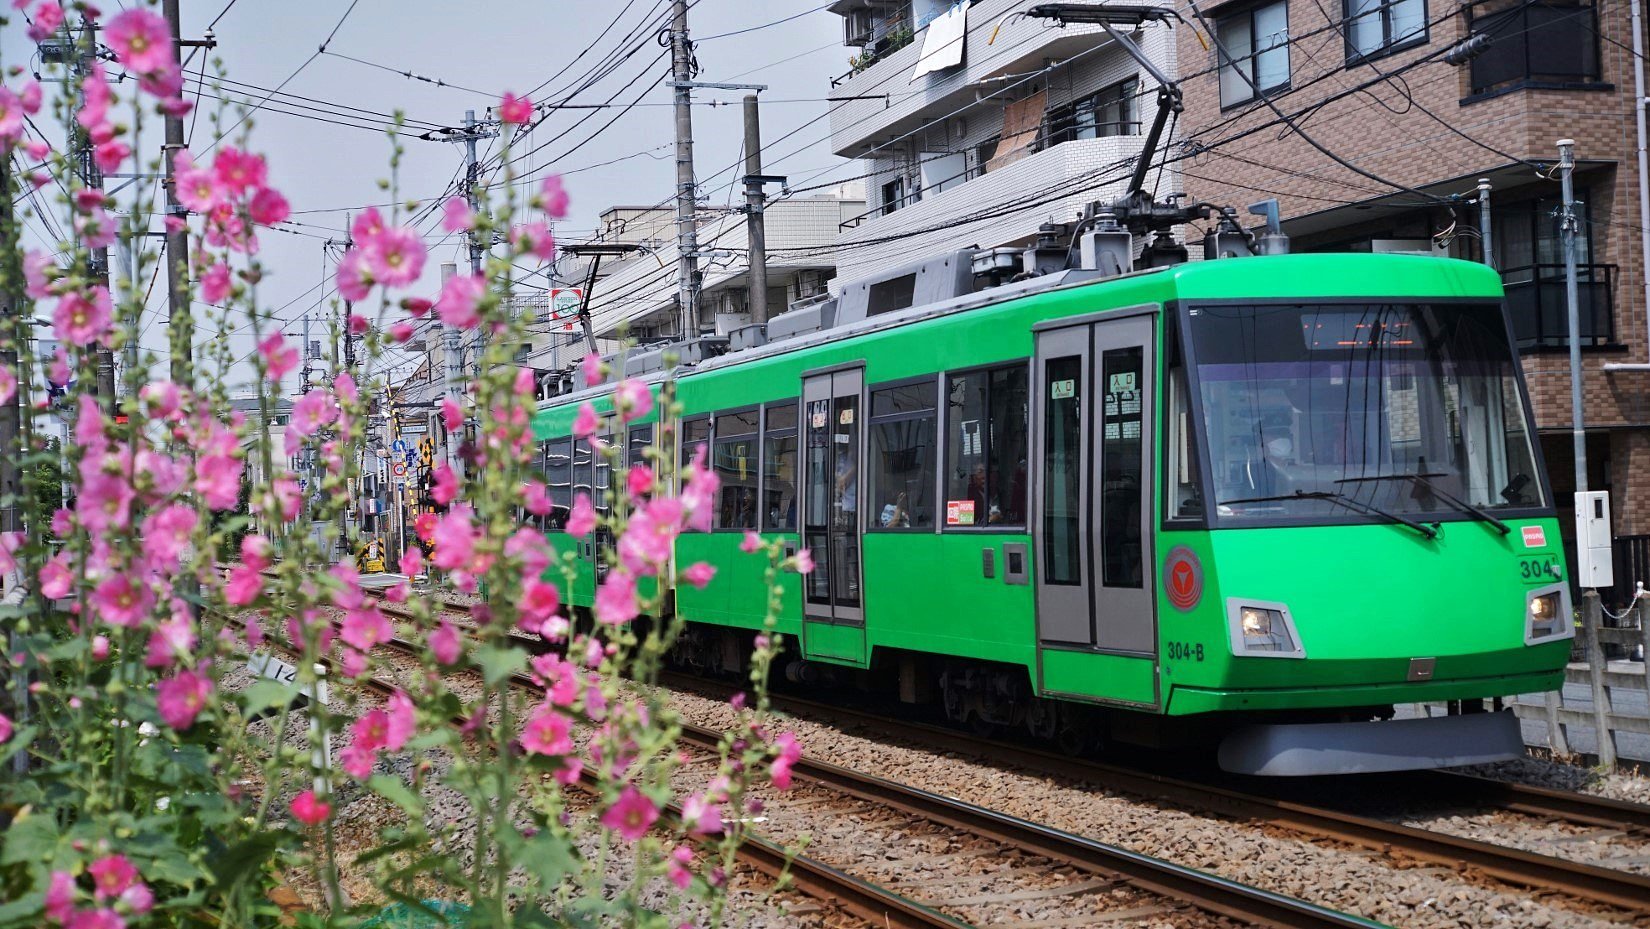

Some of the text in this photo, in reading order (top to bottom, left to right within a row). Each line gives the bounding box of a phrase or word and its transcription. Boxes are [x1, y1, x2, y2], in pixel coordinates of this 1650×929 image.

[1054, 381, 1072, 393] 入口
[1113, 374, 1133, 386] 入口
[1520, 559, 1553, 579] 304
[1168, 641, 1205, 662] 304-B
